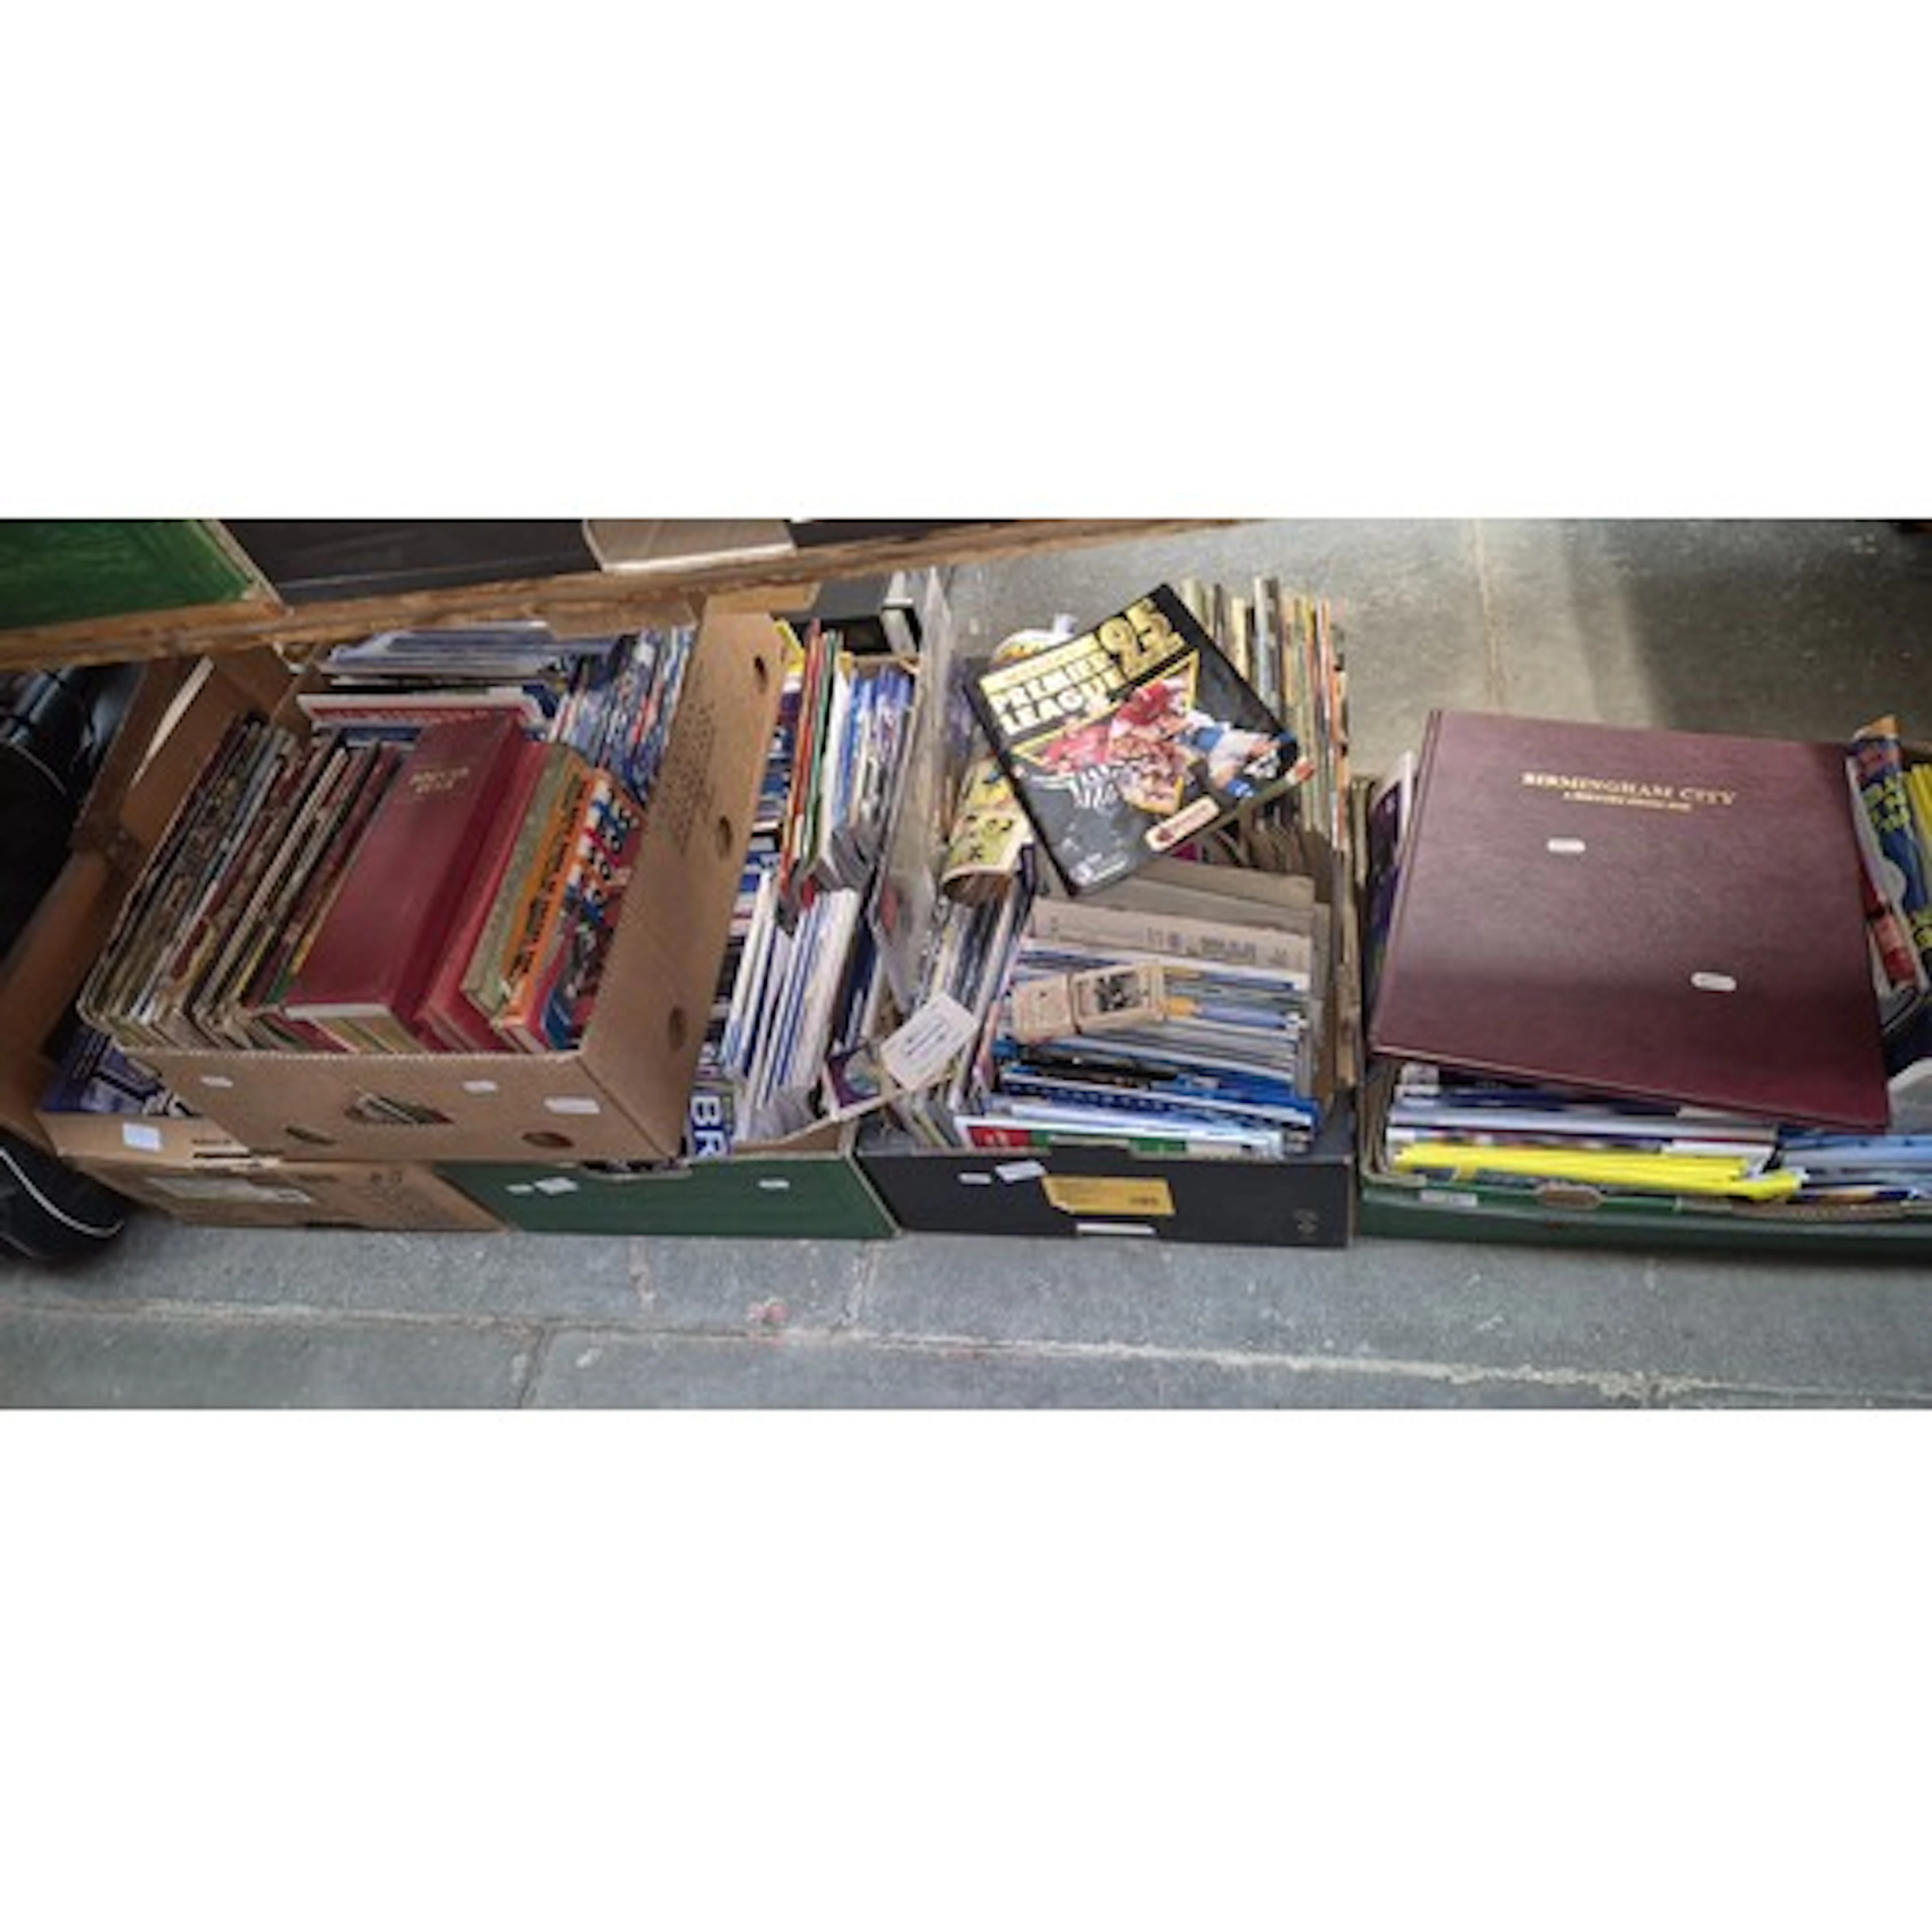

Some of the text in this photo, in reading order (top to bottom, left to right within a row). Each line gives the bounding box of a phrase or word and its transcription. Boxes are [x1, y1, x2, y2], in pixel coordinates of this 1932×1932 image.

[985, 653, 1118, 713] PREMIER
[997, 668, 1130, 736] LEAGUE
[1521, 772, 1673, 798] BIRMINGHAM
[1678, 786, 1737, 805] CITY
